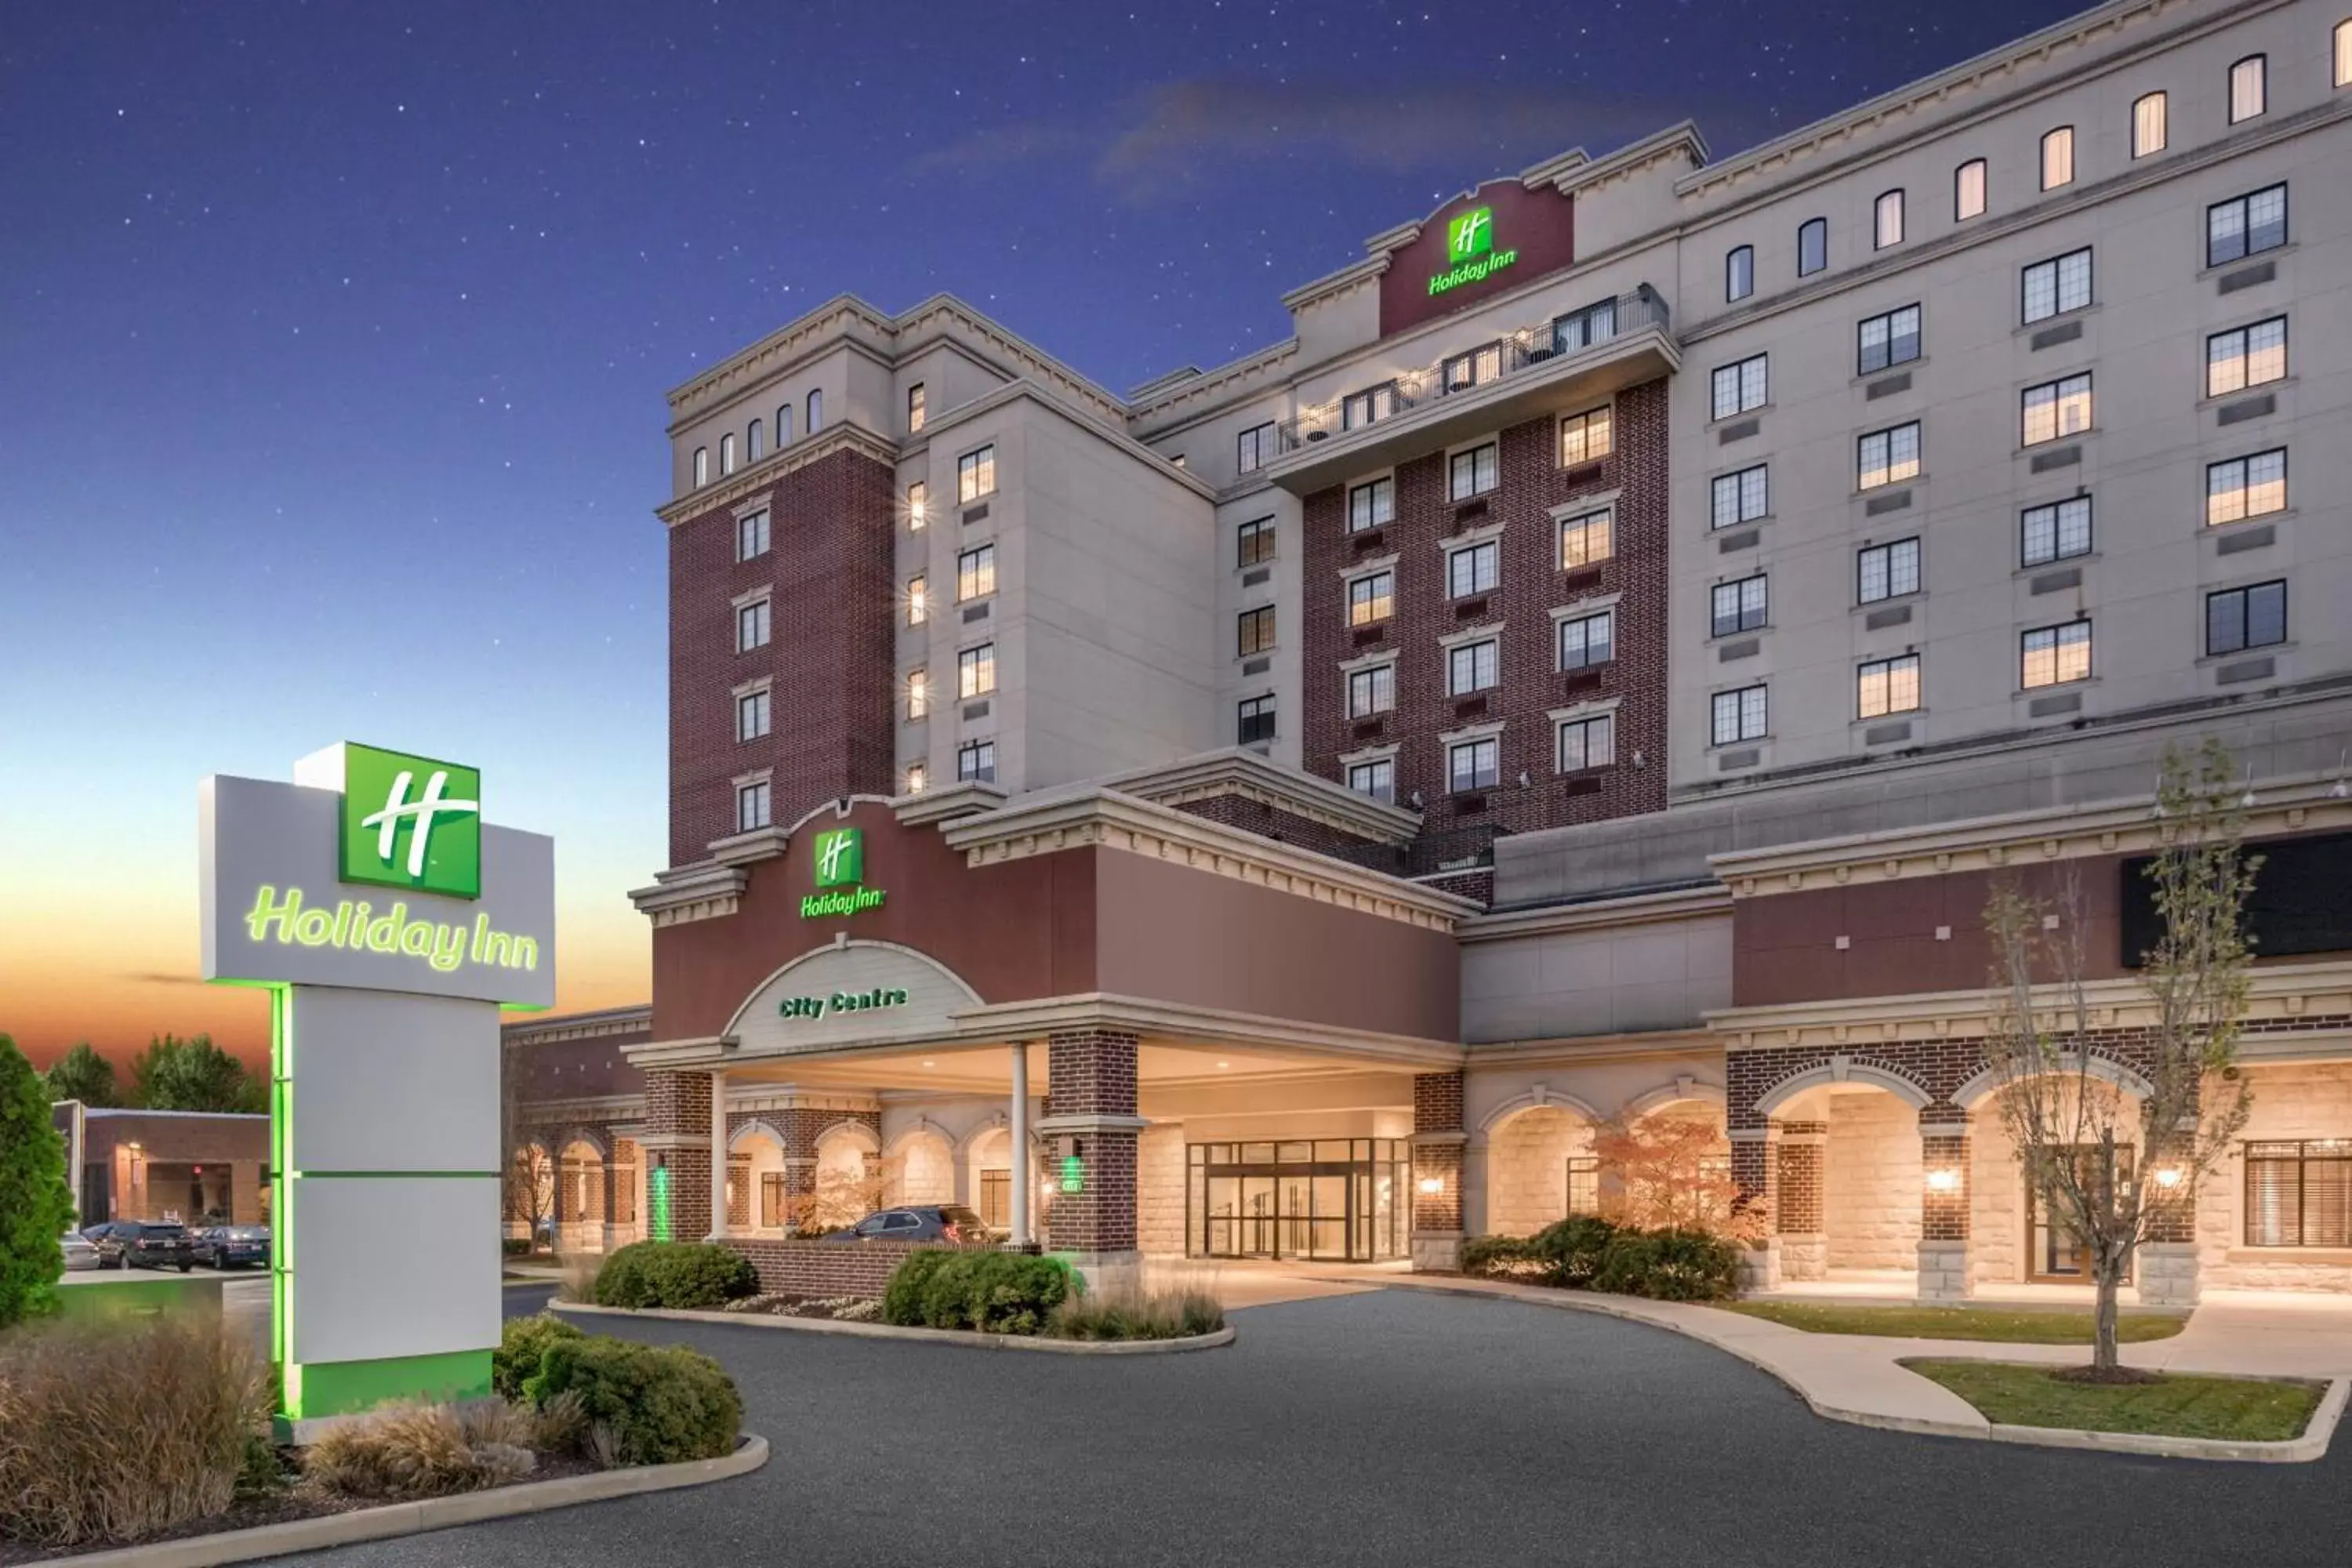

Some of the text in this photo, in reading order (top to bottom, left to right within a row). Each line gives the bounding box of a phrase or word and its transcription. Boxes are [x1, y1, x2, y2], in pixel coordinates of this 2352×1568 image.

[1429, 250, 1515, 295] Holiday Inn
[800, 886, 880, 918] Holiday Inn
[245, 886, 538, 971] Holiday Inn
[779, 989, 908, 1020] City Centre
